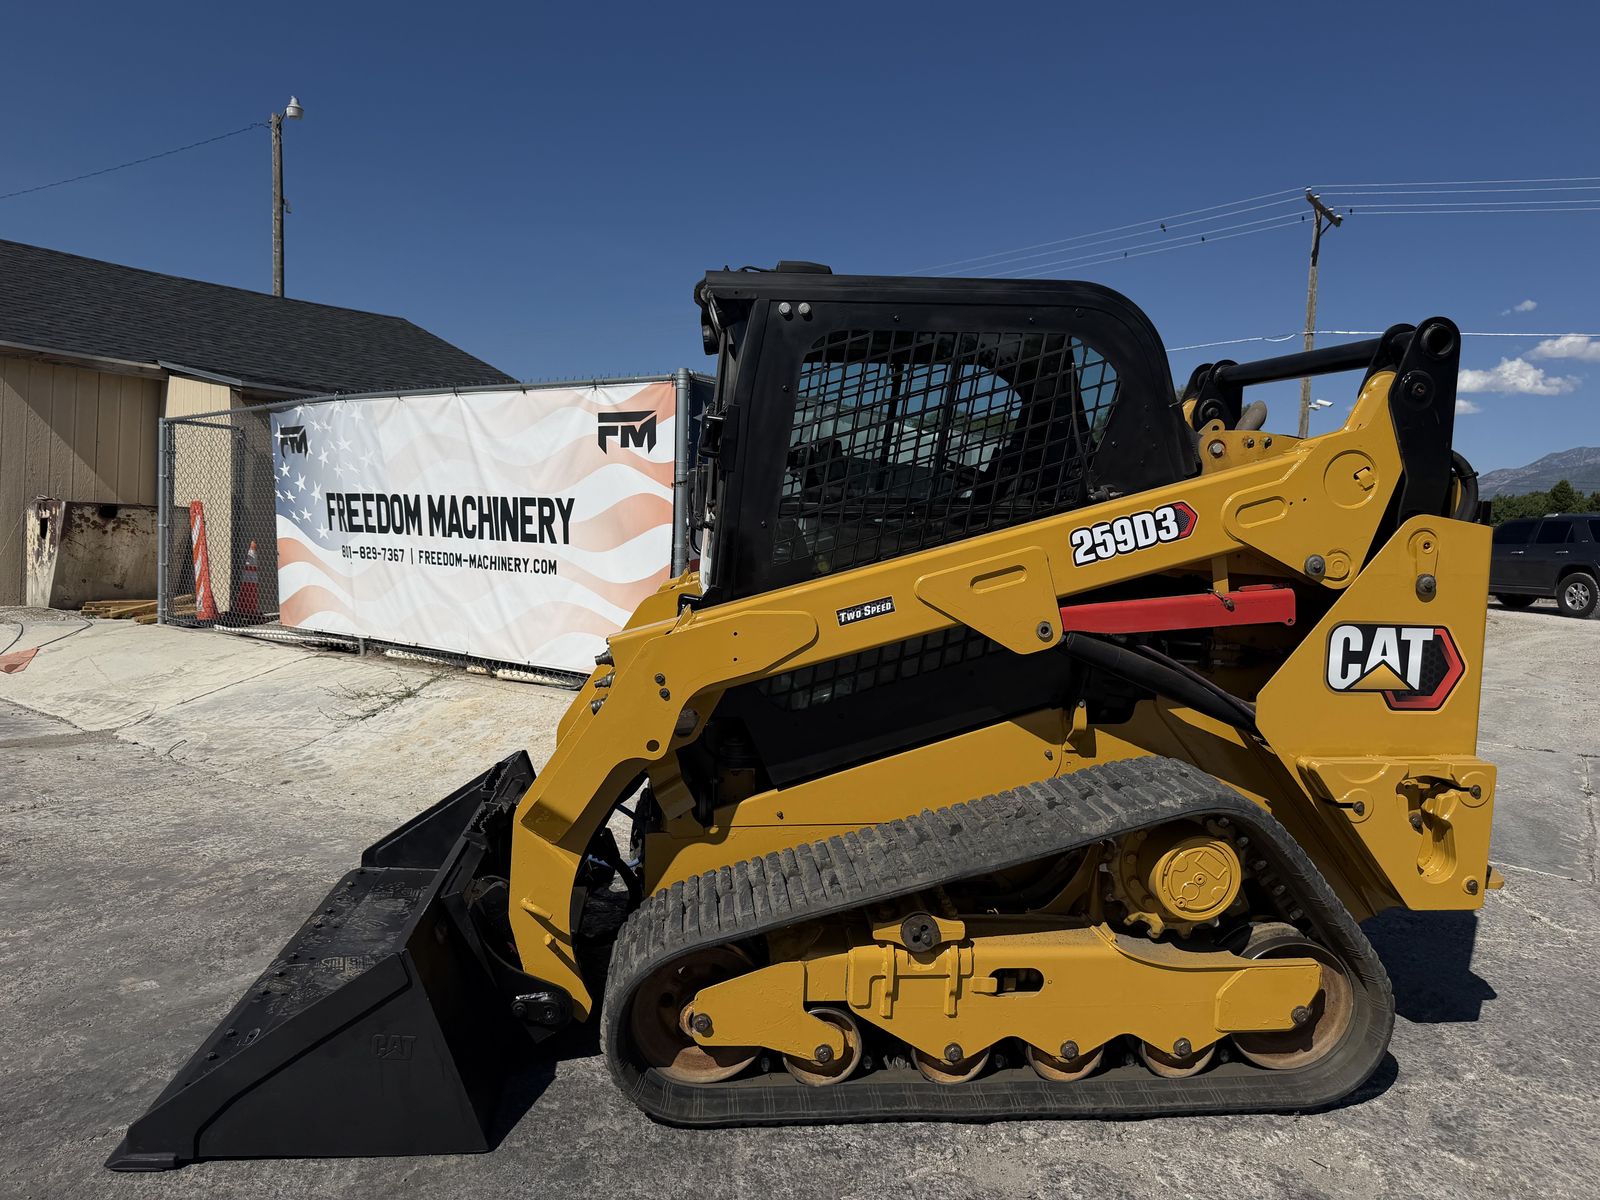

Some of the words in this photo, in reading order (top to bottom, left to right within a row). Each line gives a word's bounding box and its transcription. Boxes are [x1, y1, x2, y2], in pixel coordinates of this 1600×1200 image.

[598, 410, 657, 455] FM
[326, 492, 423, 536] FREEDOM
[427, 495, 575, 544] MACHINERY
[1071, 506, 1179, 565] 259D3
[341, 545, 405, 562] 801-829-7367
[418, 550, 557, 575] FREEDOM-MACHINERY.COM
[1327, 625, 1435, 691] CAT
[371, 1034, 417, 1060] CAT
